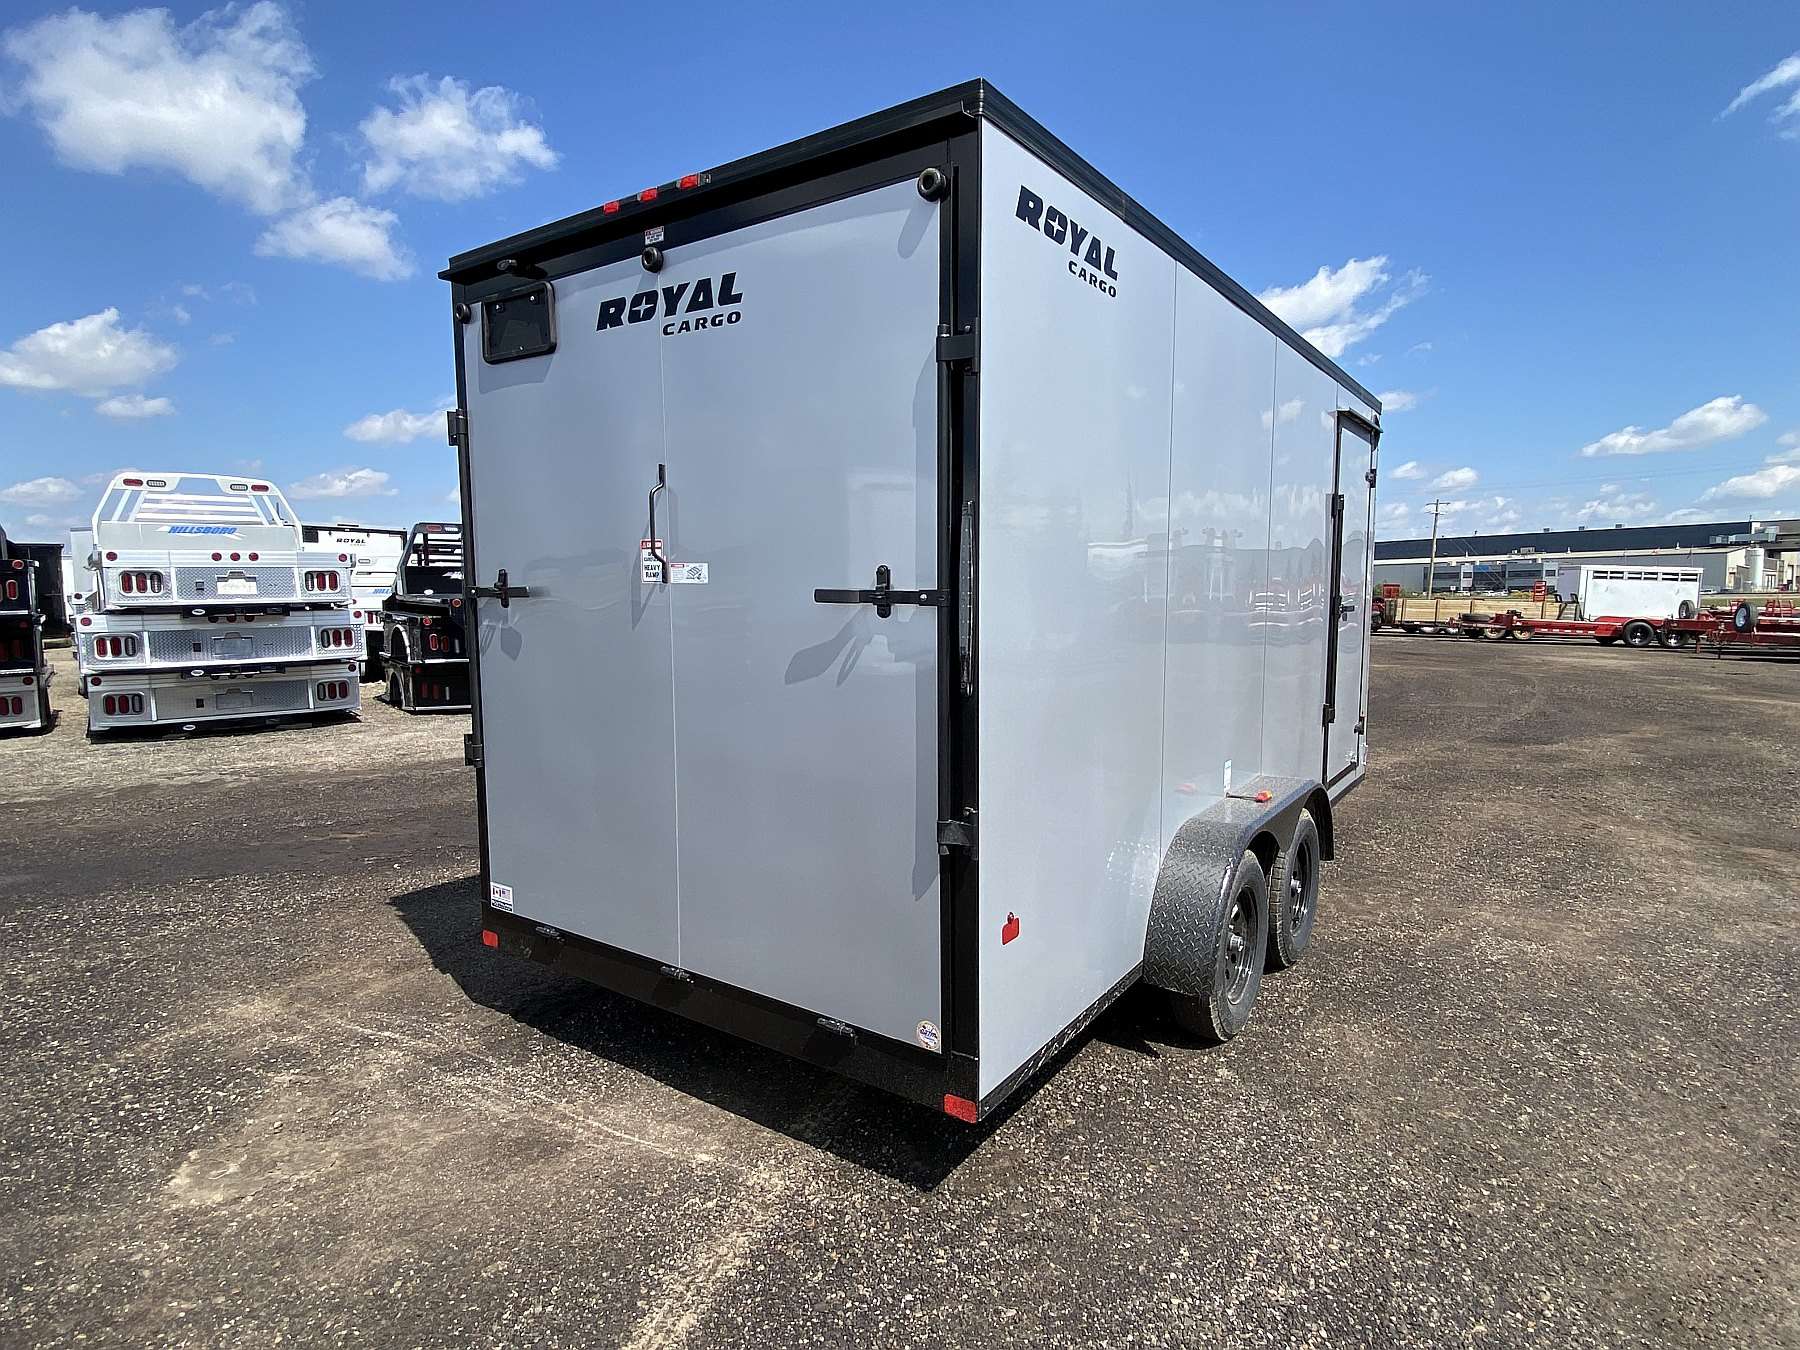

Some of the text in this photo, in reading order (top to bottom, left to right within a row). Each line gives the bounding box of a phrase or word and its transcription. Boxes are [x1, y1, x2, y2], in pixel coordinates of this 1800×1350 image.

[1015, 184, 1119, 281] ROYAL
[1068, 260, 1117, 298] CARGO
[596, 271, 743, 331] ROYAL
[662, 310, 742, 336] CARGO
[168, 525, 238, 535] HILLSBORO
